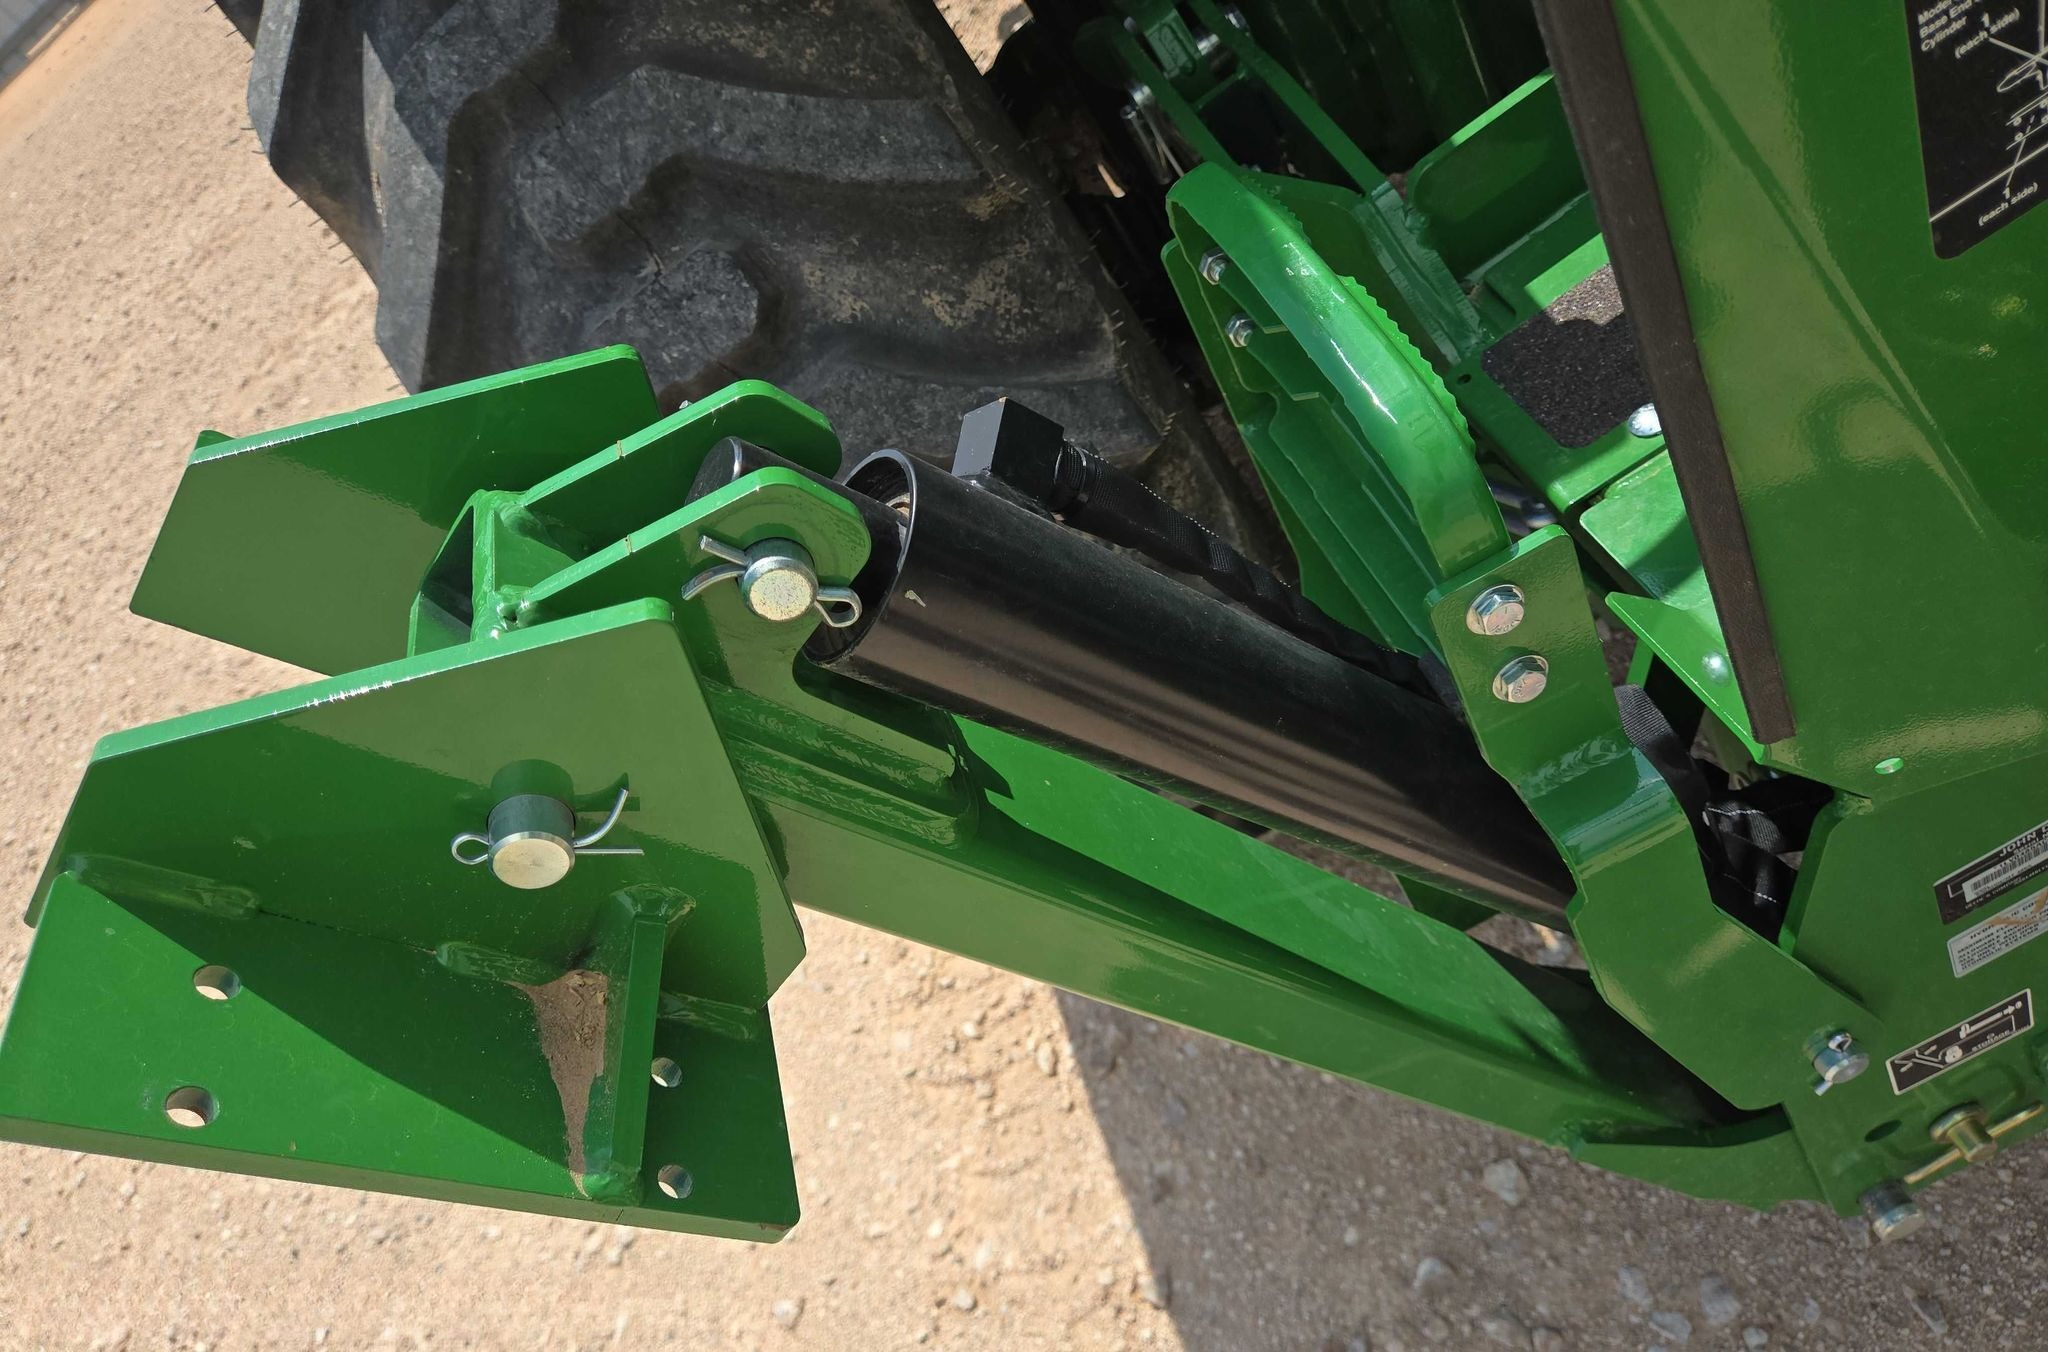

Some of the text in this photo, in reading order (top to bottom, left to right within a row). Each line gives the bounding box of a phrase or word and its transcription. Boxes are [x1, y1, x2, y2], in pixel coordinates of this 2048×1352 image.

[1920, 0, 1972, 39] Base End
[1921, 16, 1967, 52] Cylinder
[1955, 8, 2020, 59] (each side)
[1981, 12, 1990, 27] 1
[1978, 182, 2038, 226] (each side)
[2003, 187, 2010, 199] 1
[2000, 831, 2036, 857] JOHN
